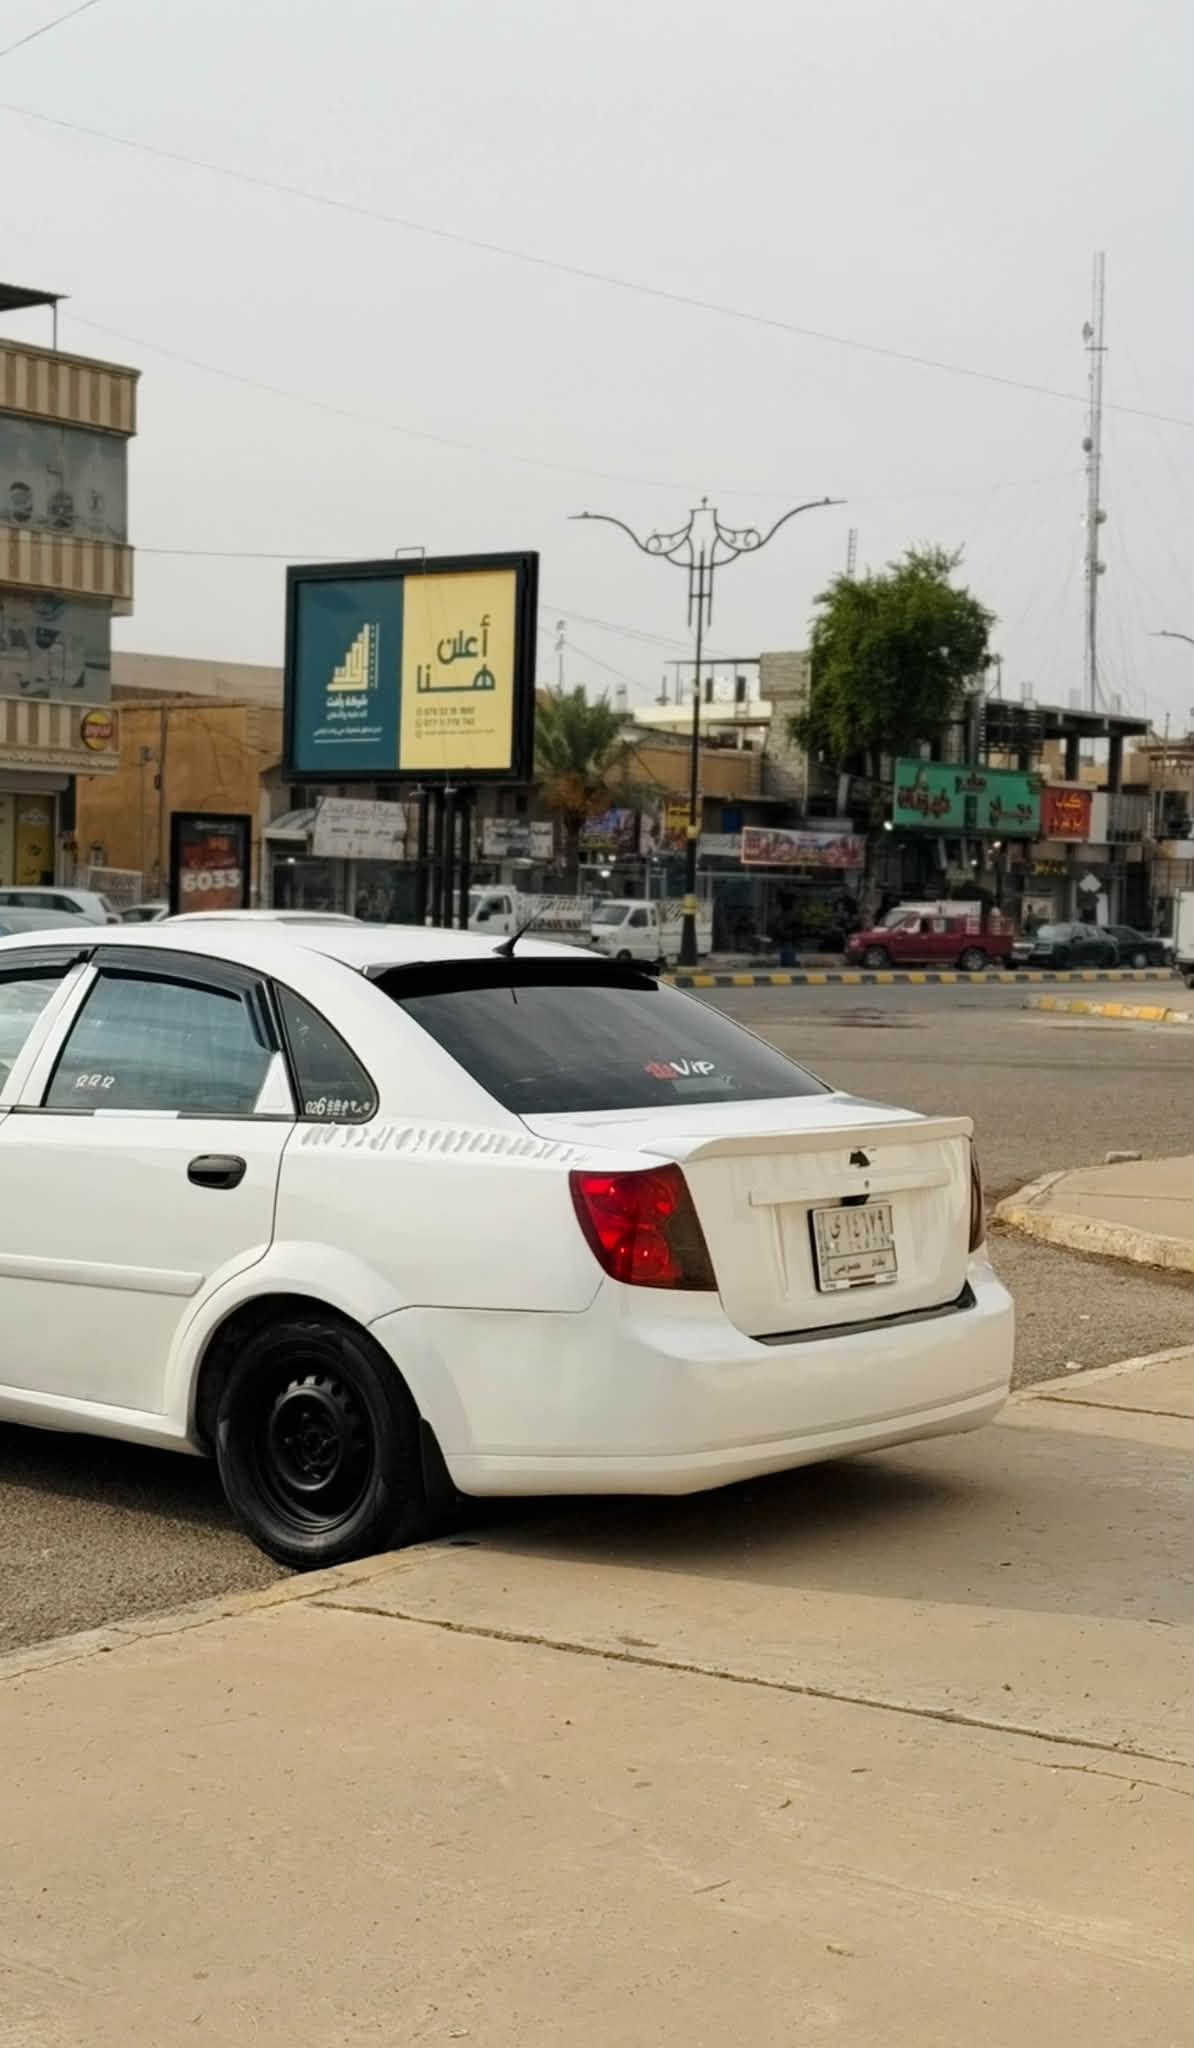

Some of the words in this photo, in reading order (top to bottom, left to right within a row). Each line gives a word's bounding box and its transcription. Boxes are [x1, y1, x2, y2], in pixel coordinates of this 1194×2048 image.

[436, 613, 491, 665] أعلن
[416, 663, 496, 694] هنا
[182, 868, 240, 892] 6033
